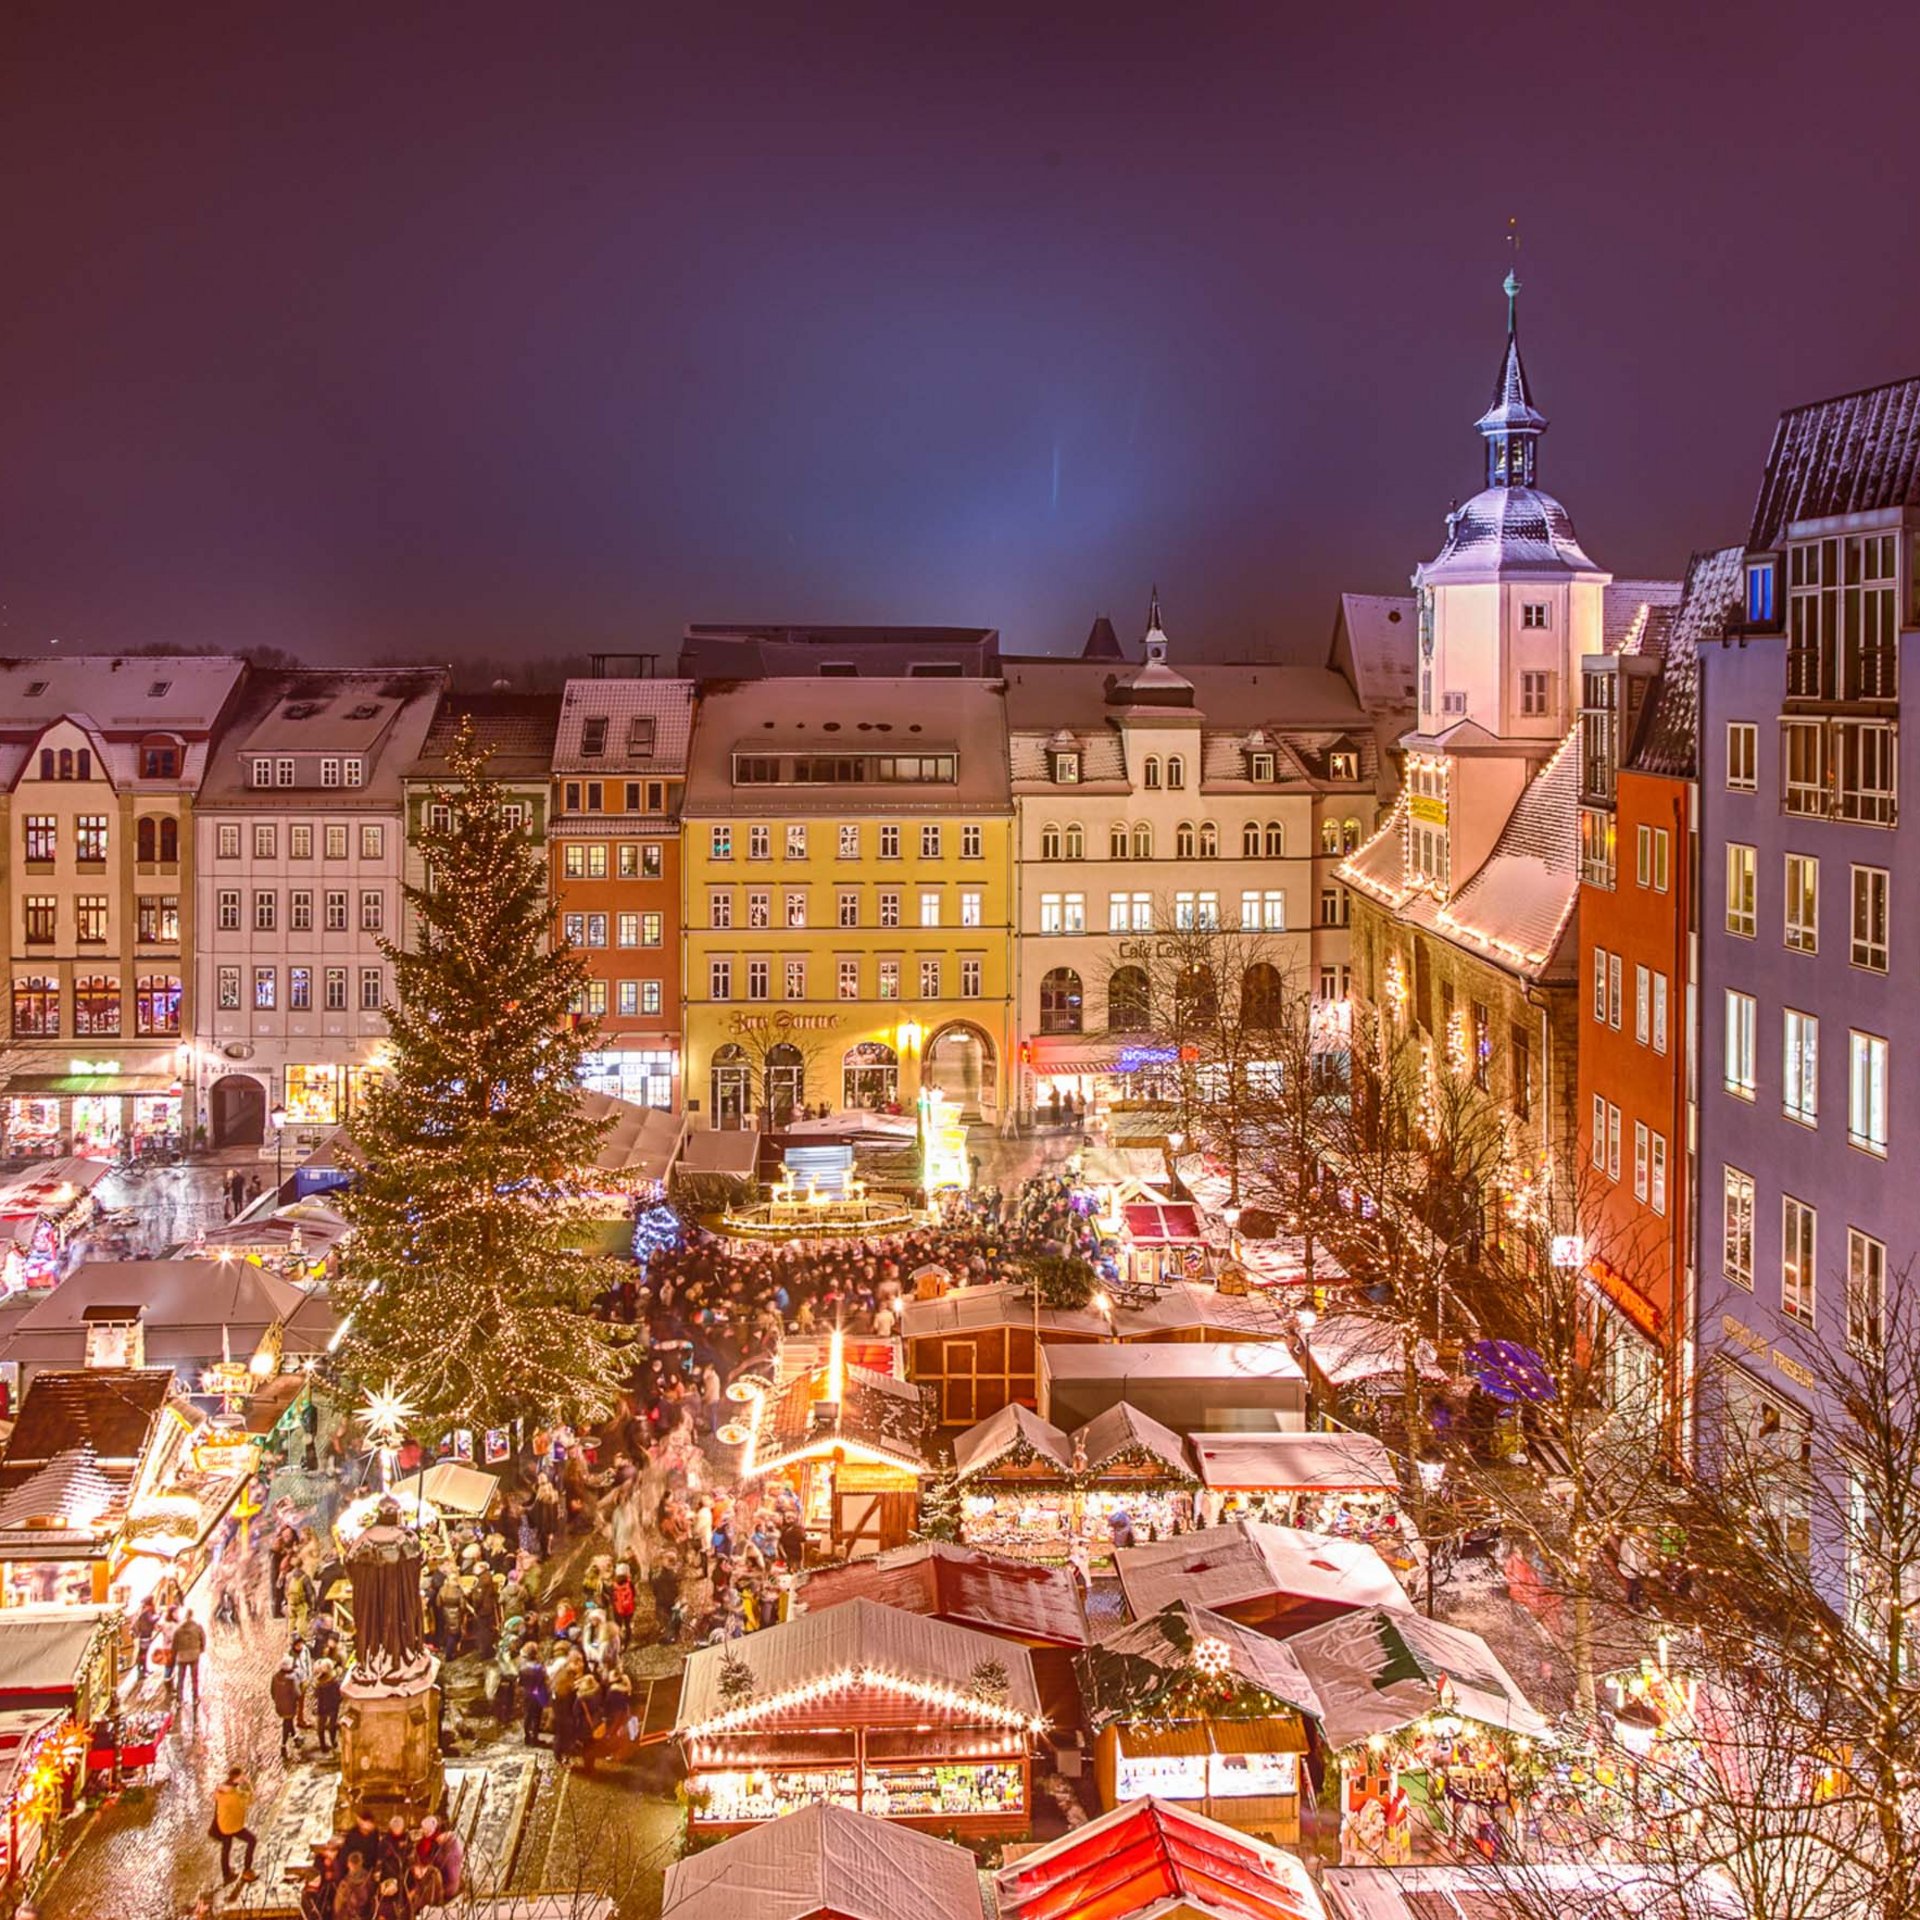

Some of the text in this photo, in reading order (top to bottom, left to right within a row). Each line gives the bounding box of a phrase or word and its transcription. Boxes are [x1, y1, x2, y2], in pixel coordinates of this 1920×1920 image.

[1119, 939, 1151, 958] Café
[728, 1009, 839, 1035] Zur Sonne
